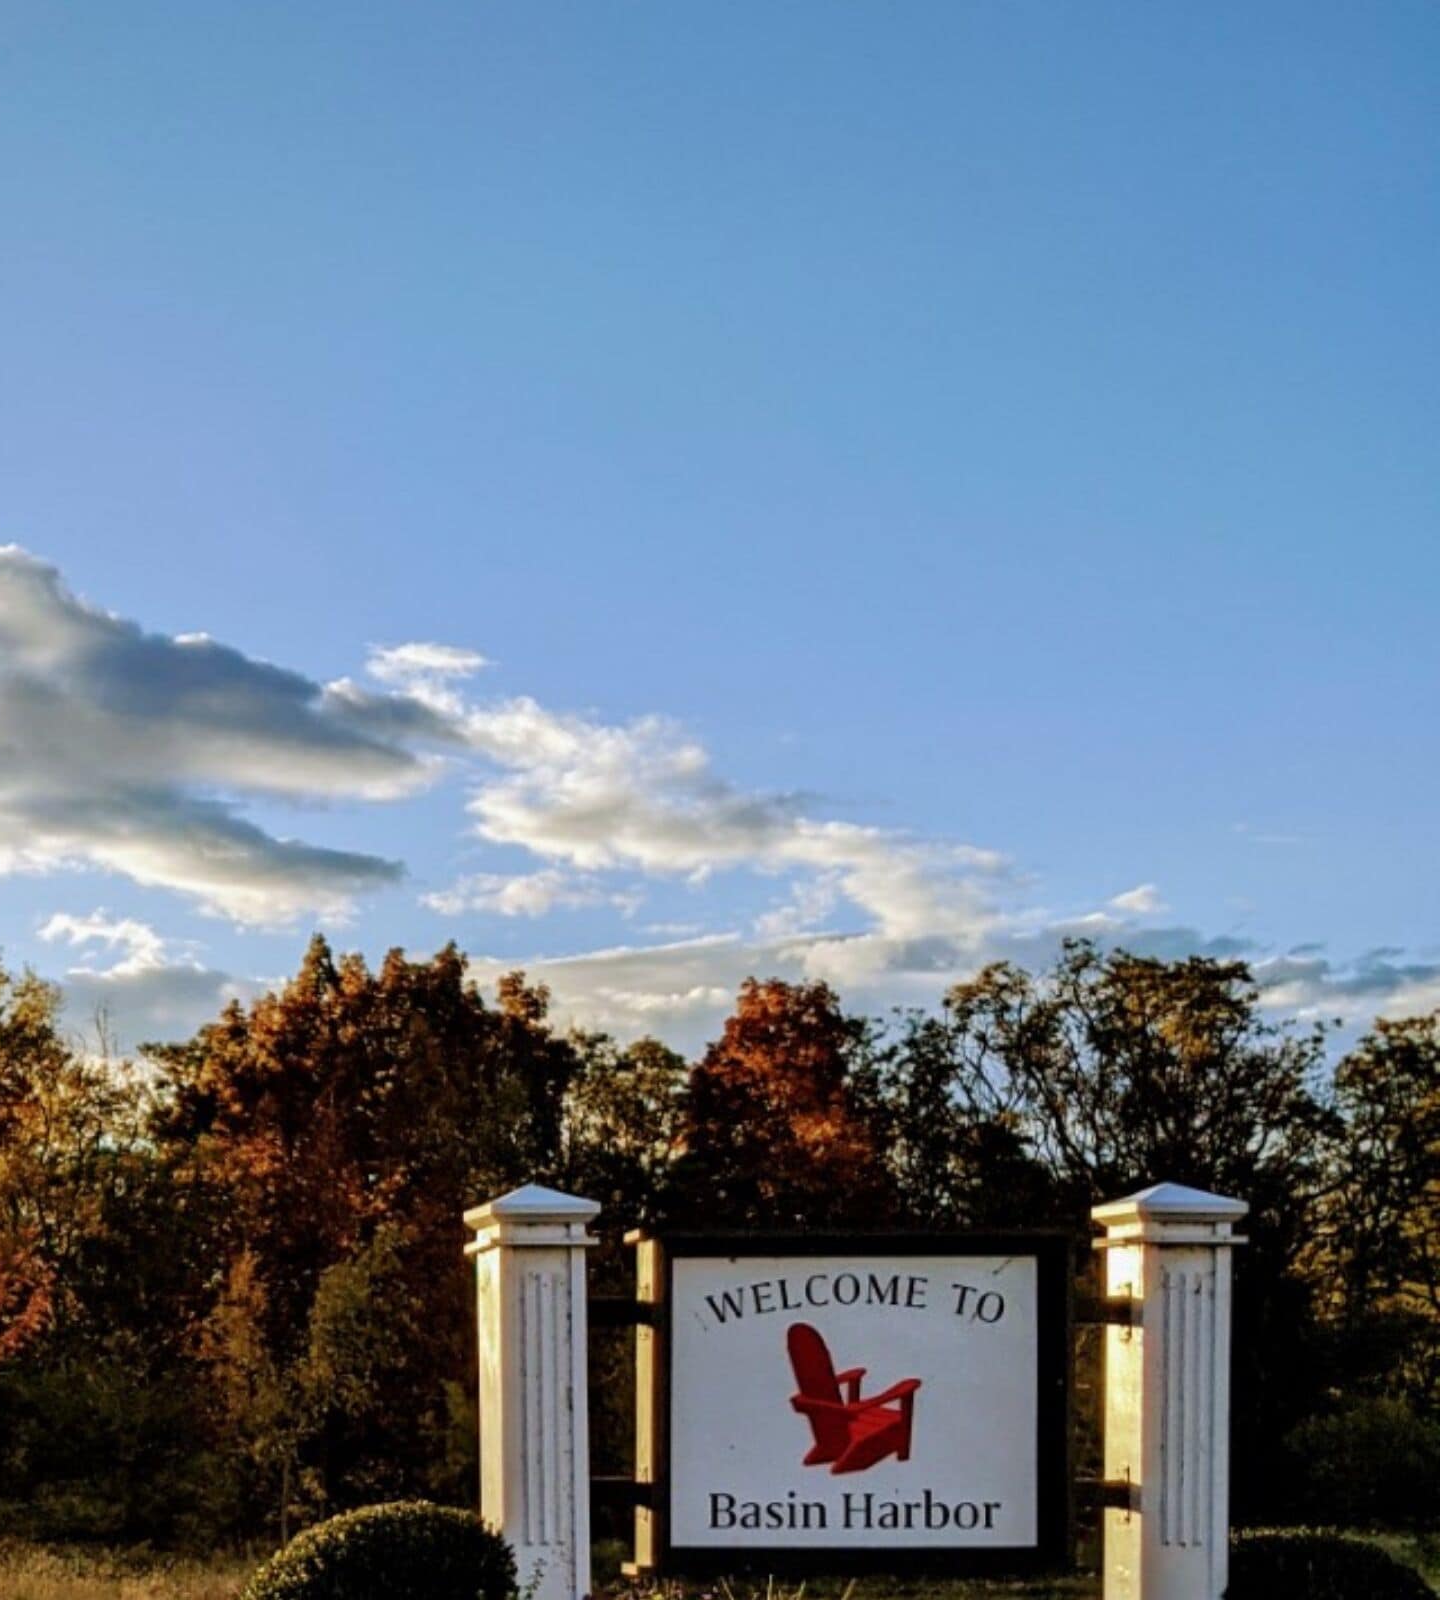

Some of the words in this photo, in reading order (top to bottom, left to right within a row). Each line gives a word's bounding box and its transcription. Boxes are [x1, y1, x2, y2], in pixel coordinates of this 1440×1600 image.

[705, 1273, 929, 1323] WELCOME
[951, 1283, 1006, 1323] TO
[708, 1491, 827, 1530] Basin
[842, 1490, 1002, 1530] Harbor
